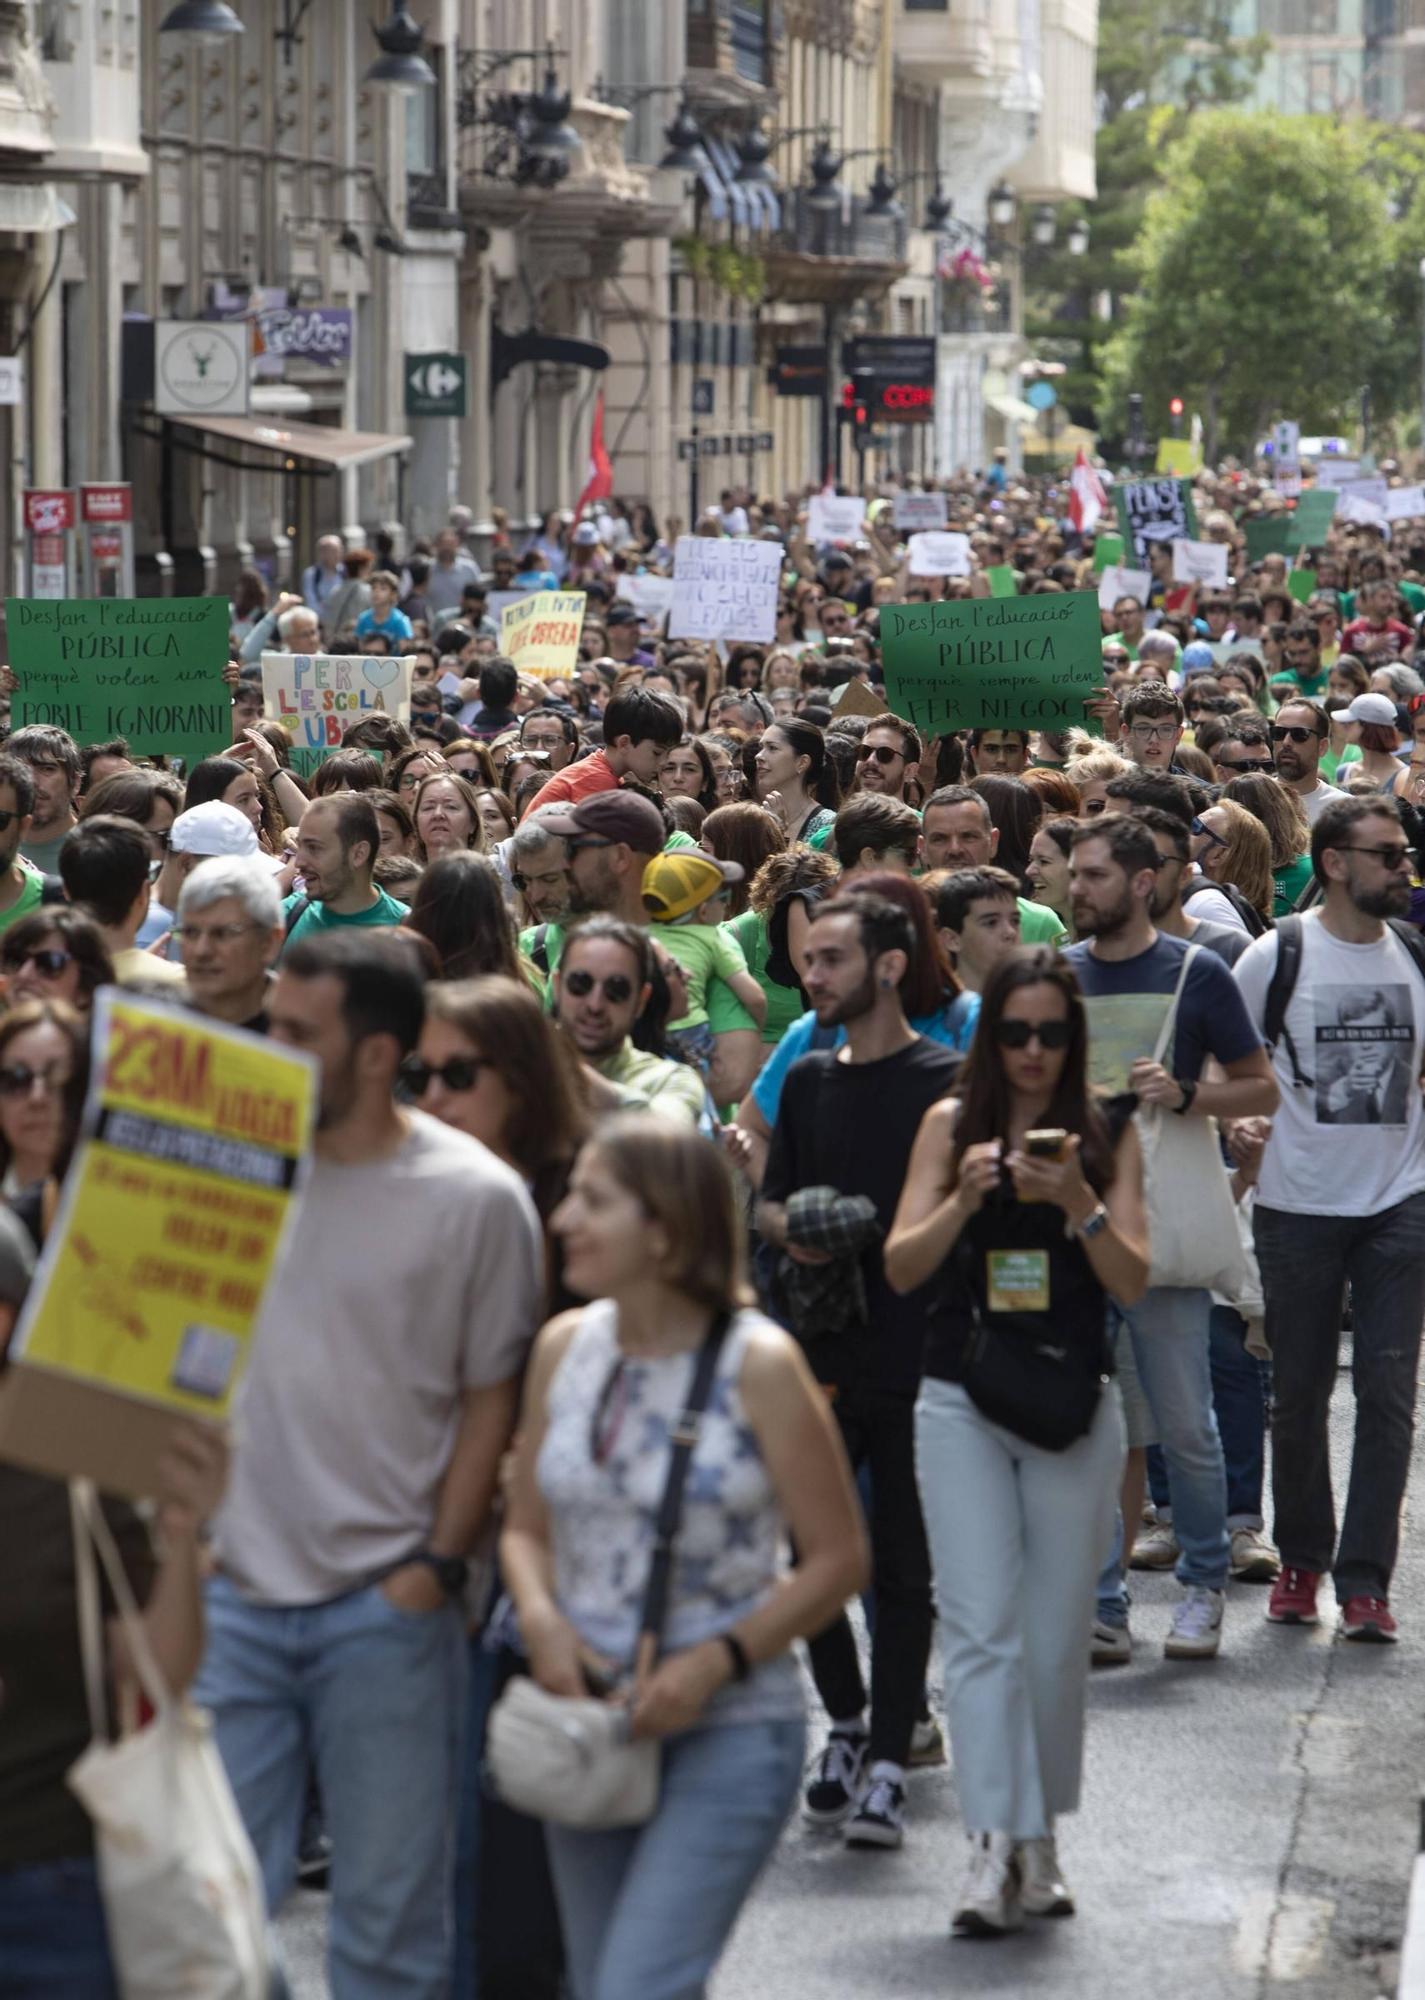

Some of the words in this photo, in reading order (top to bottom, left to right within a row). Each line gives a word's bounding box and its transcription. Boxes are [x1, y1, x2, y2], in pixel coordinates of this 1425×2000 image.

[19, 603, 88, 632] Desfan
[100, 604, 212, 626] l'educació
[893, 605, 965, 637] Desfan
[973, 601, 1075, 627] l'educació
[61, 631, 181, 660] PÚBLICA
[939, 635, 1056, 667] PÚBLICA
[22, 668, 80, 694] perquè
[96, 667, 160, 685] volen
[174, 670, 216, 682] un
[294, 656, 352, 690] PER
[897, 673, 963, 697] perquè
[978, 674, 1042, 691] sempre
[1051, 664, 1102, 684] volen
[278, 688, 385, 714] L'ESCOLA
[908, 698, 964, 725] FER
[23, 702, 95, 732] POBLE
[104, 1012, 212, 1110] 23M
